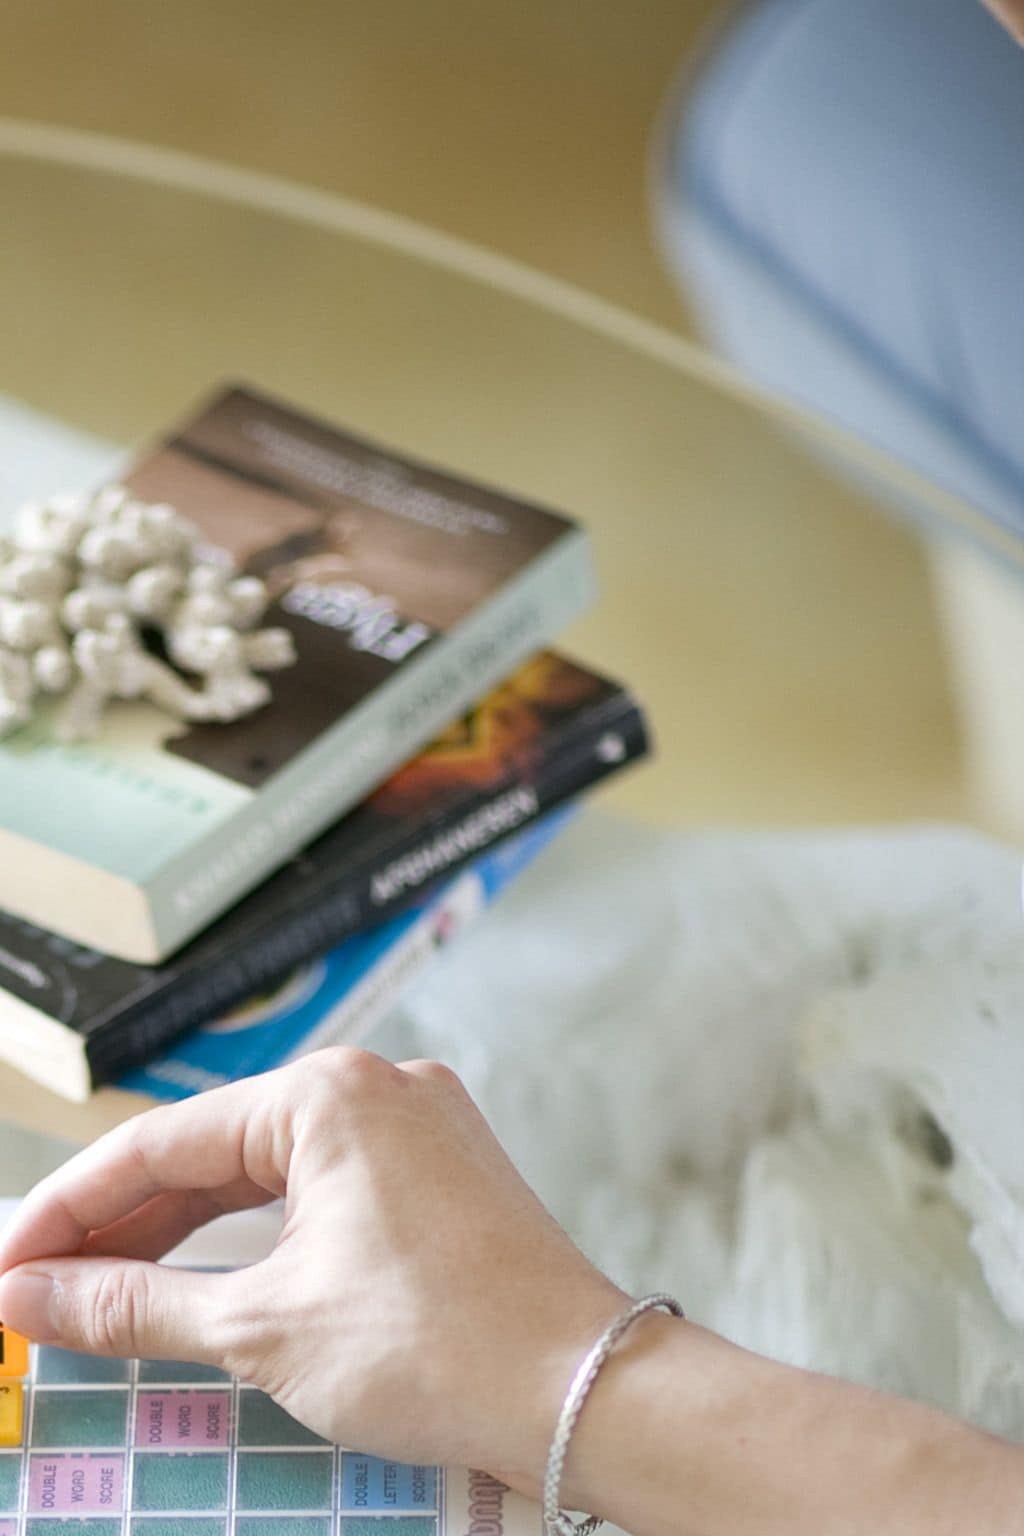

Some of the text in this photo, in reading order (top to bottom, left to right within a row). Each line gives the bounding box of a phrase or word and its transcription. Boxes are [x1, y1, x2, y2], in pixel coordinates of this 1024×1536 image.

[149, 1400, 163, 1443] DOUBLE
[178, 1405, 192, 1437] WORD
[206, 1402, 220, 1440] SCORE
[41, 1465, 57, 1508] DOUBLE
[70, 1470, 85, 1504] WORD
[99, 1467, 114, 1504] SCORE
[354, 1463, 368, 1506] DOUBLE
[383, 1464, 397, 1505] LETTER
[411, 1466, 426, 1504] SCORE
